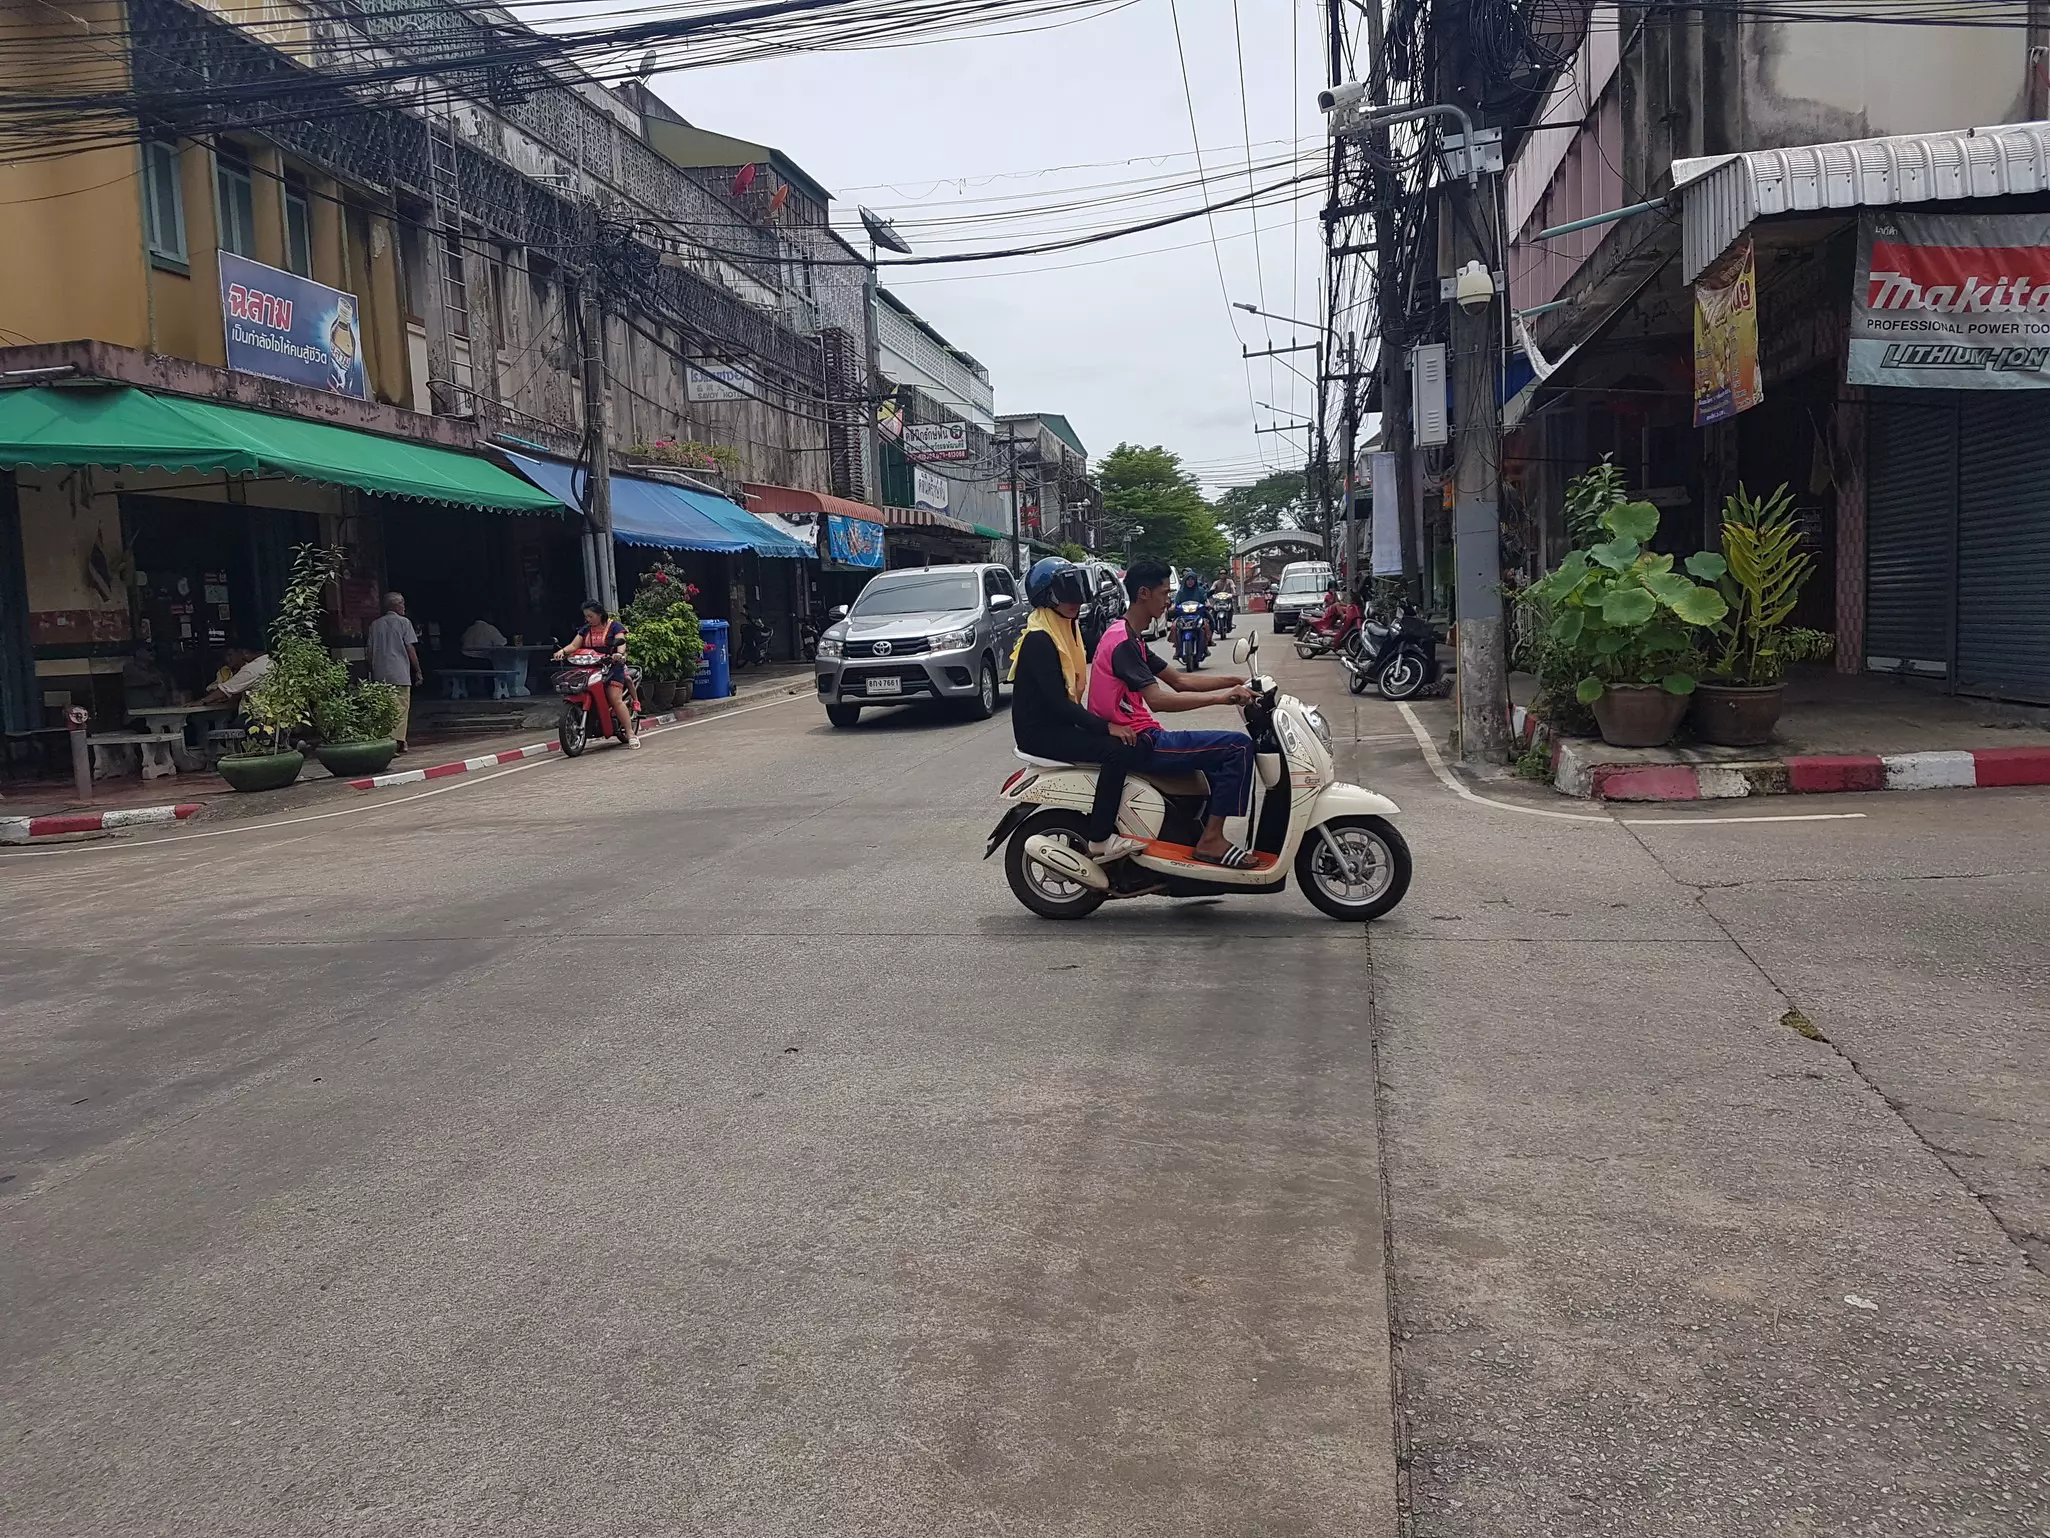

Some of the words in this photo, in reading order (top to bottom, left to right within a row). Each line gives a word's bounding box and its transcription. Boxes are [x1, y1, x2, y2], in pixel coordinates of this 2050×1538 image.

[228, 283, 293, 332] ฉลาม
[1870, 272, 2050, 313] Makita
[1867, 319, 1964, 334] PROFESSIONAL
[1968, 323, 2019, 334] POWER
[1880, 344, 2050, 371] LITHIUM-ION
